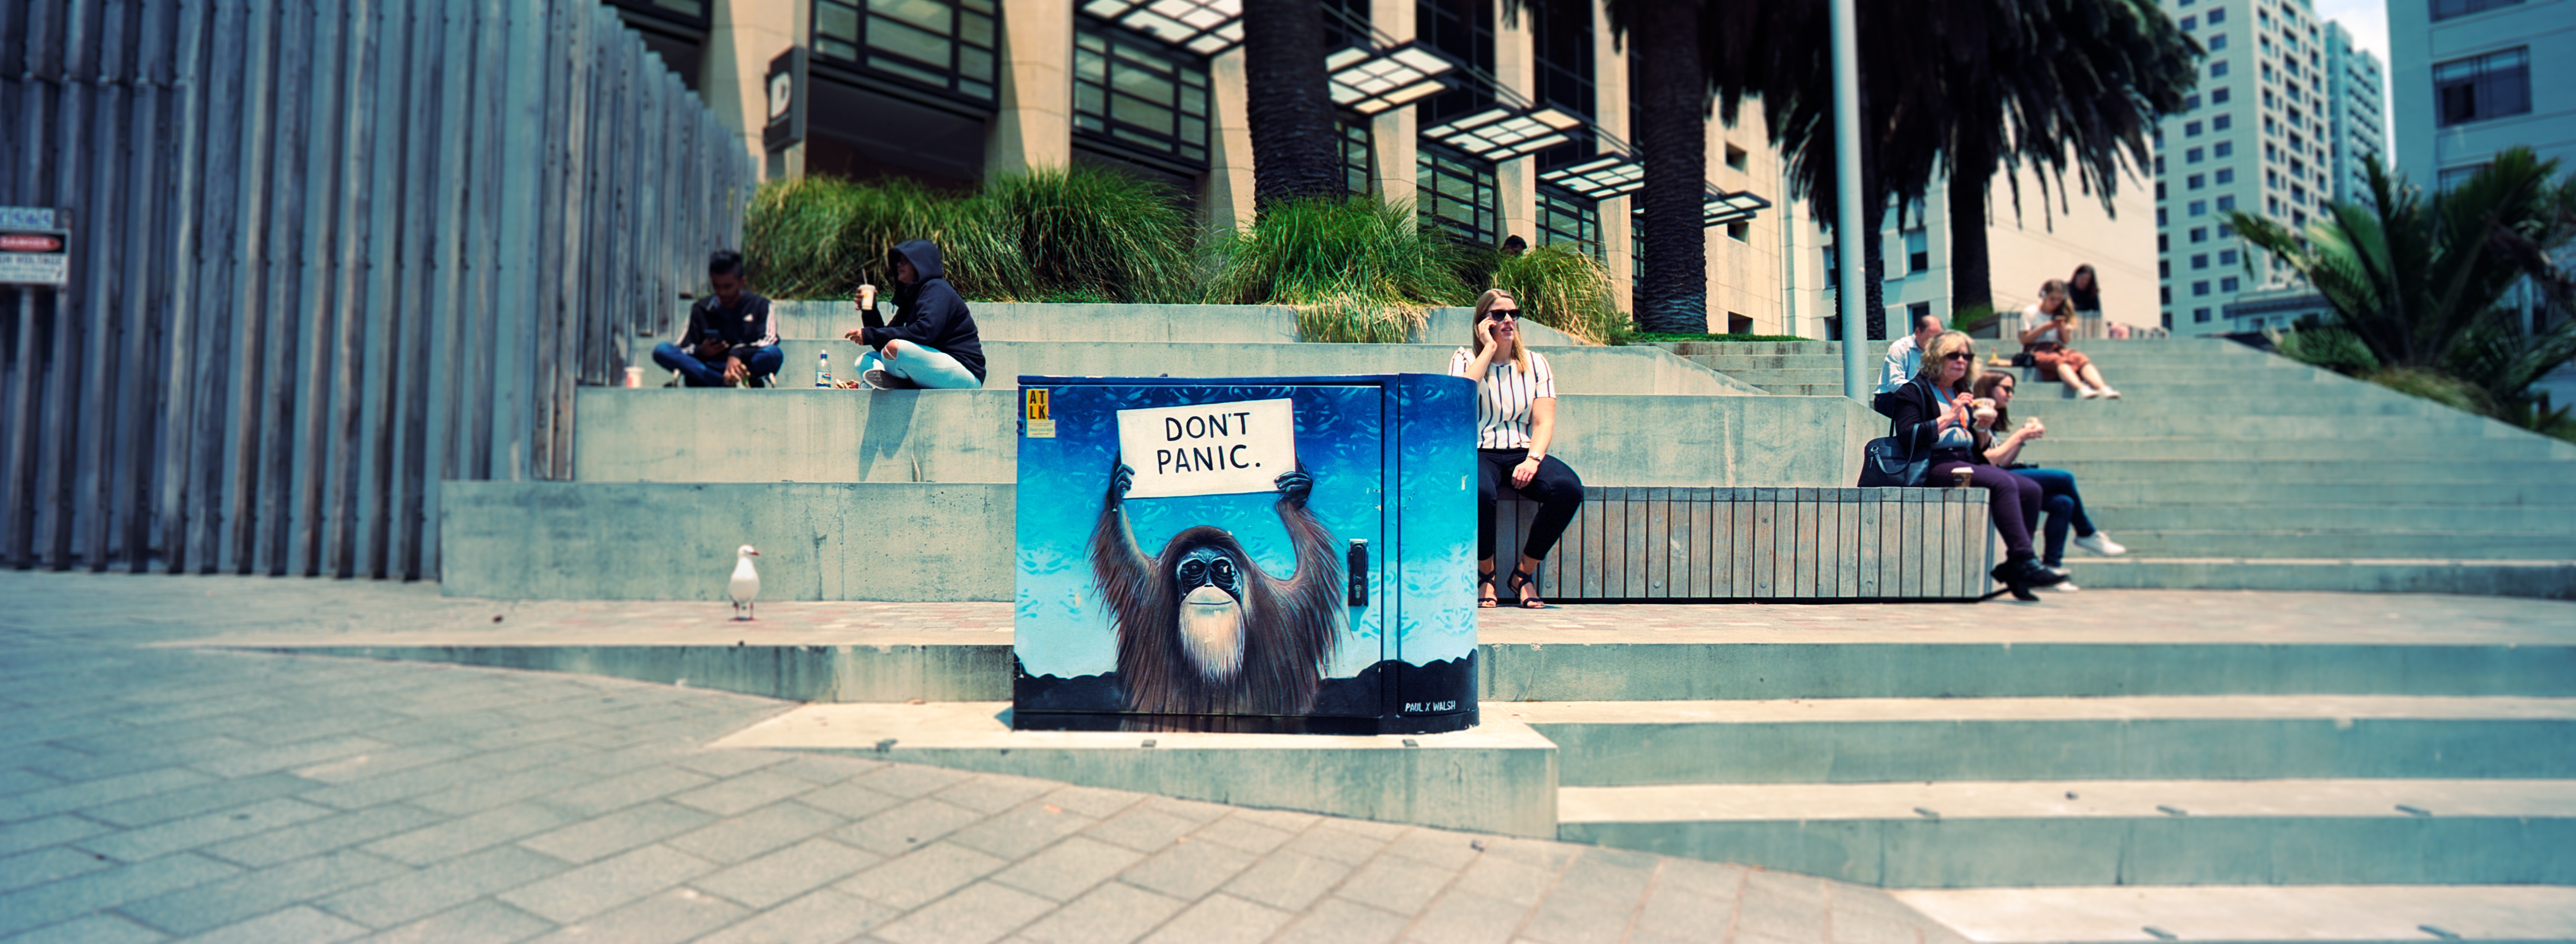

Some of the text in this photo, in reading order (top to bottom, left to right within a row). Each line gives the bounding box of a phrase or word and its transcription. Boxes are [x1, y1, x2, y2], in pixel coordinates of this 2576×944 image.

[770, 71, 791, 119] D
[1165, 412, 1250, 441] DON'T
[1157, 444, 1261, 475] PANIC.
[1405, 700, 1455, 712] PAUL X WALSH
